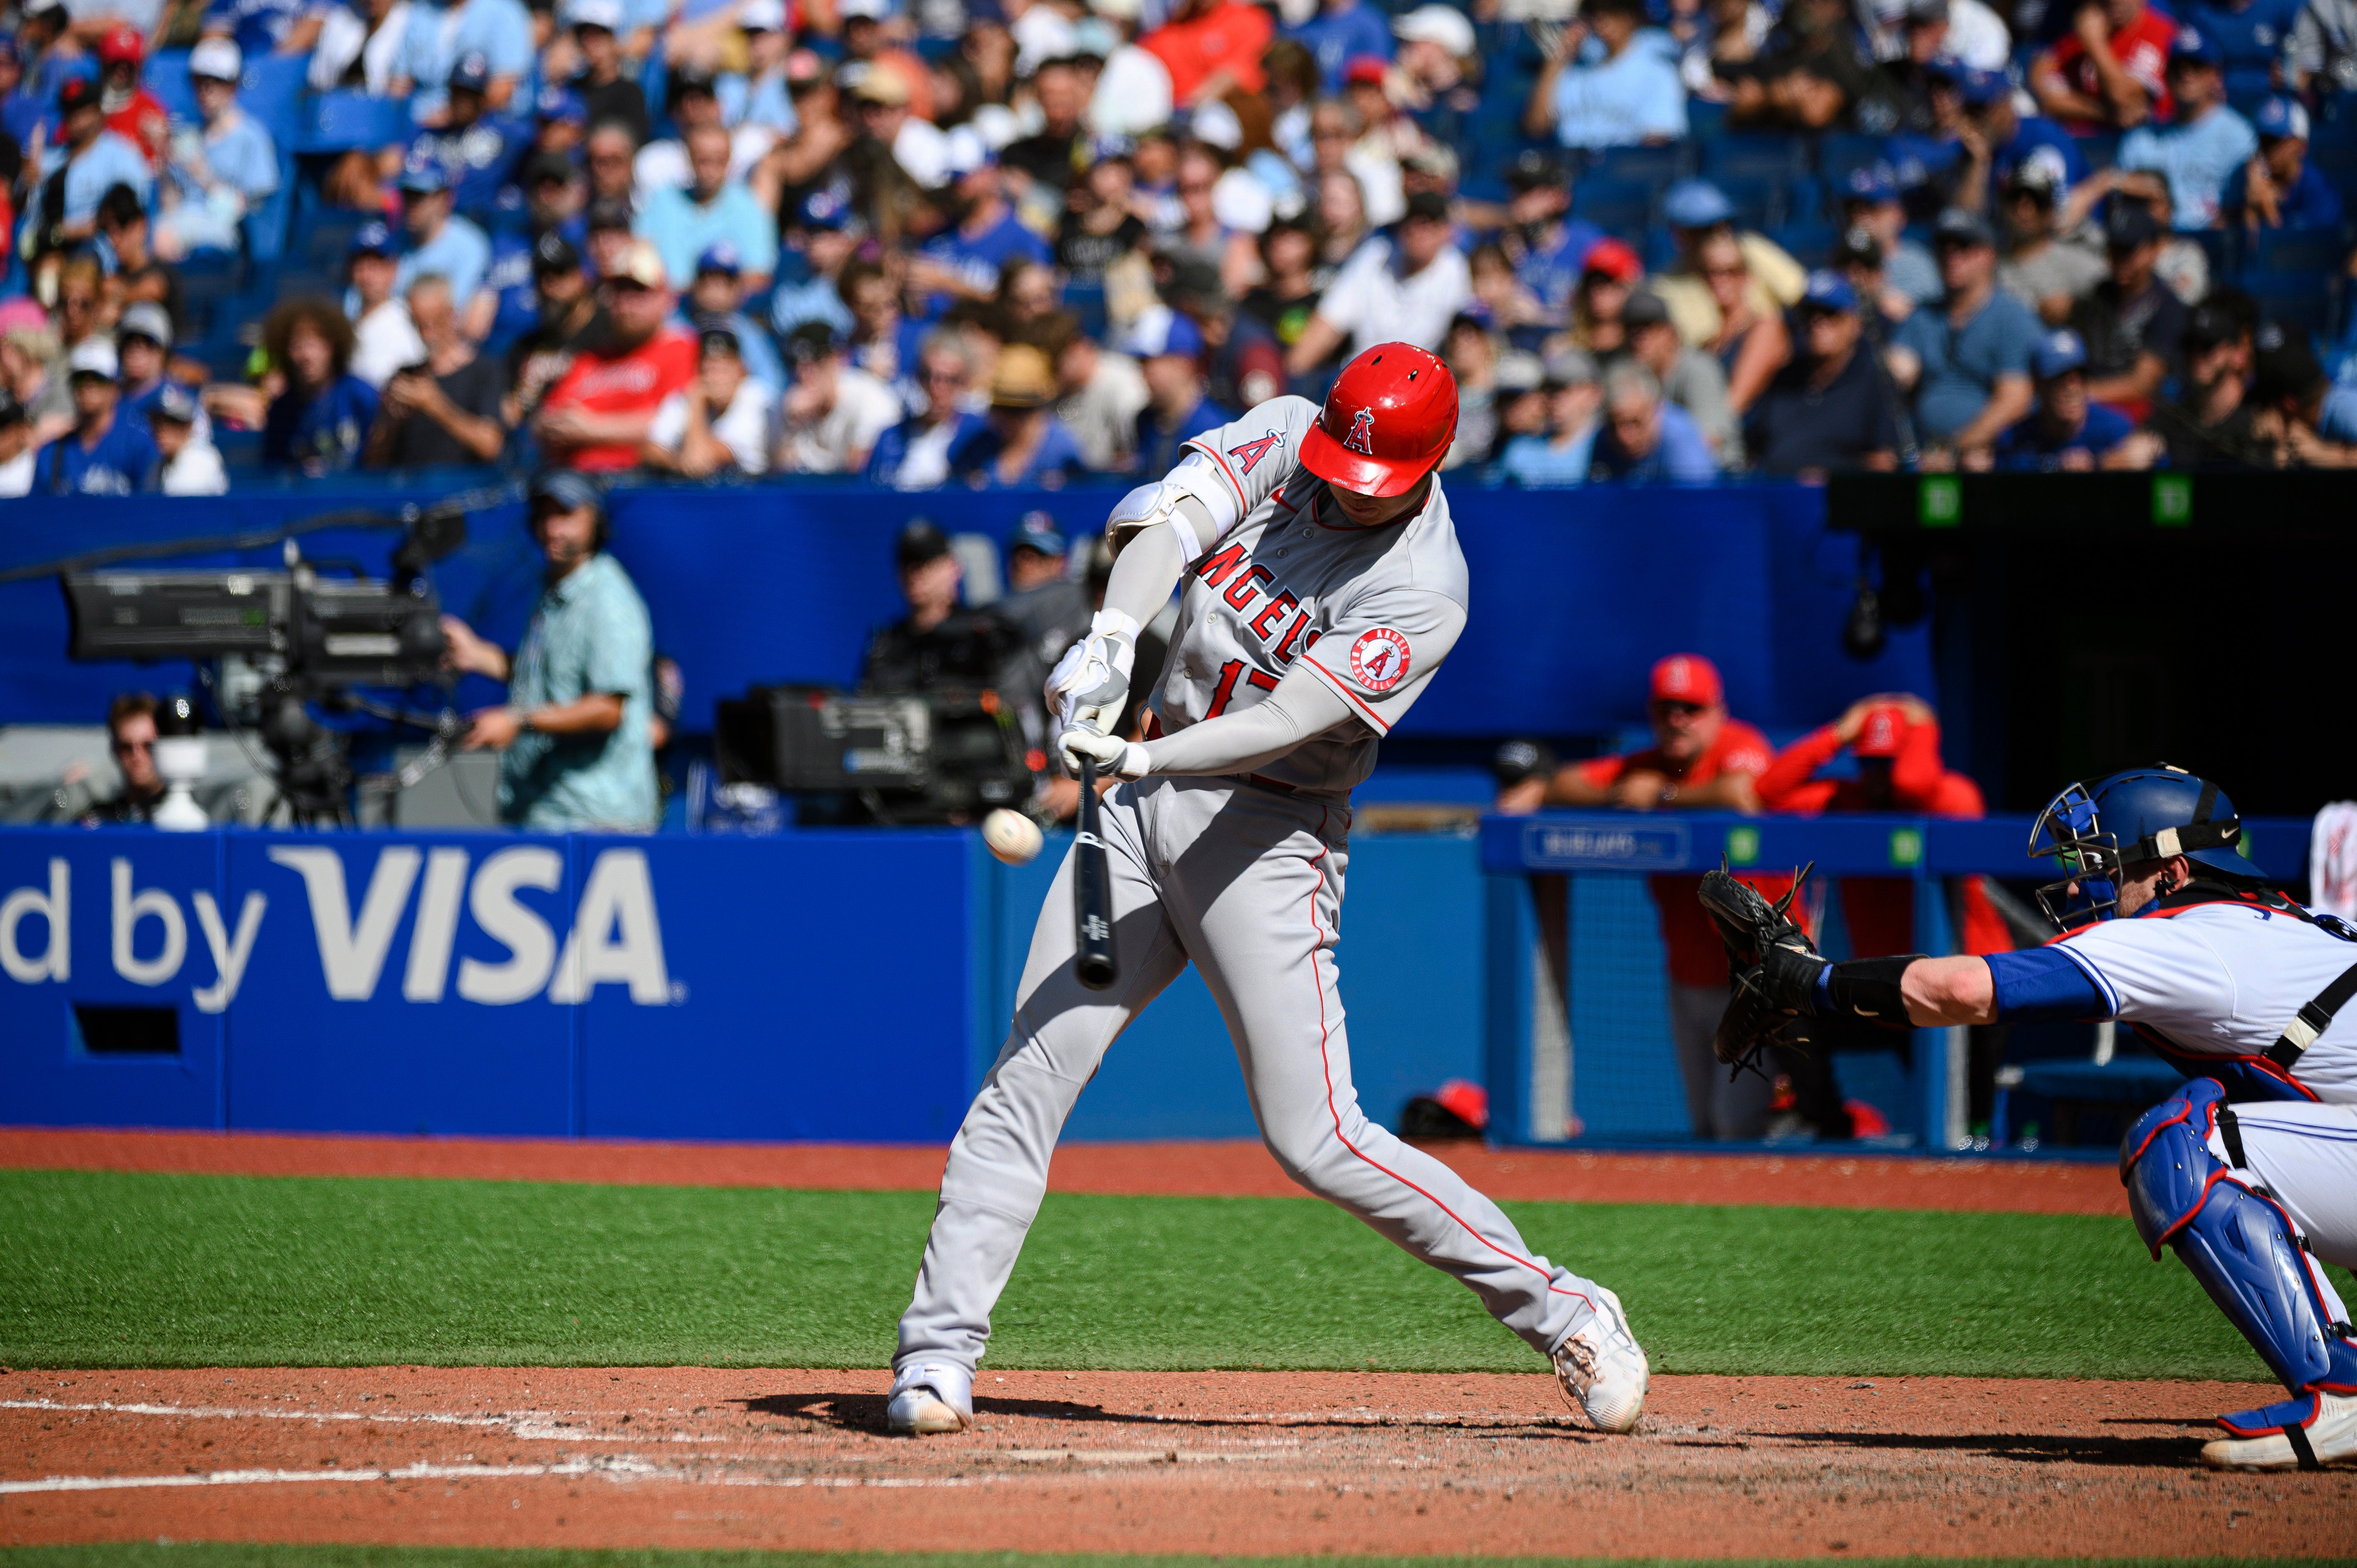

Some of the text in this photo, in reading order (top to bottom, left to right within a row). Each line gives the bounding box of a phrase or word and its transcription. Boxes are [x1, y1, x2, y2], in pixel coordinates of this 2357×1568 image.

[1193, 538, 1325, 667] NGEL
[1376, 629, 1410, 659] ANGELS
[1351, 652, 1390, 690] BASEBALL
[111, 856, 268, 1013] by
[267, 845, 670, 1005] VISA
